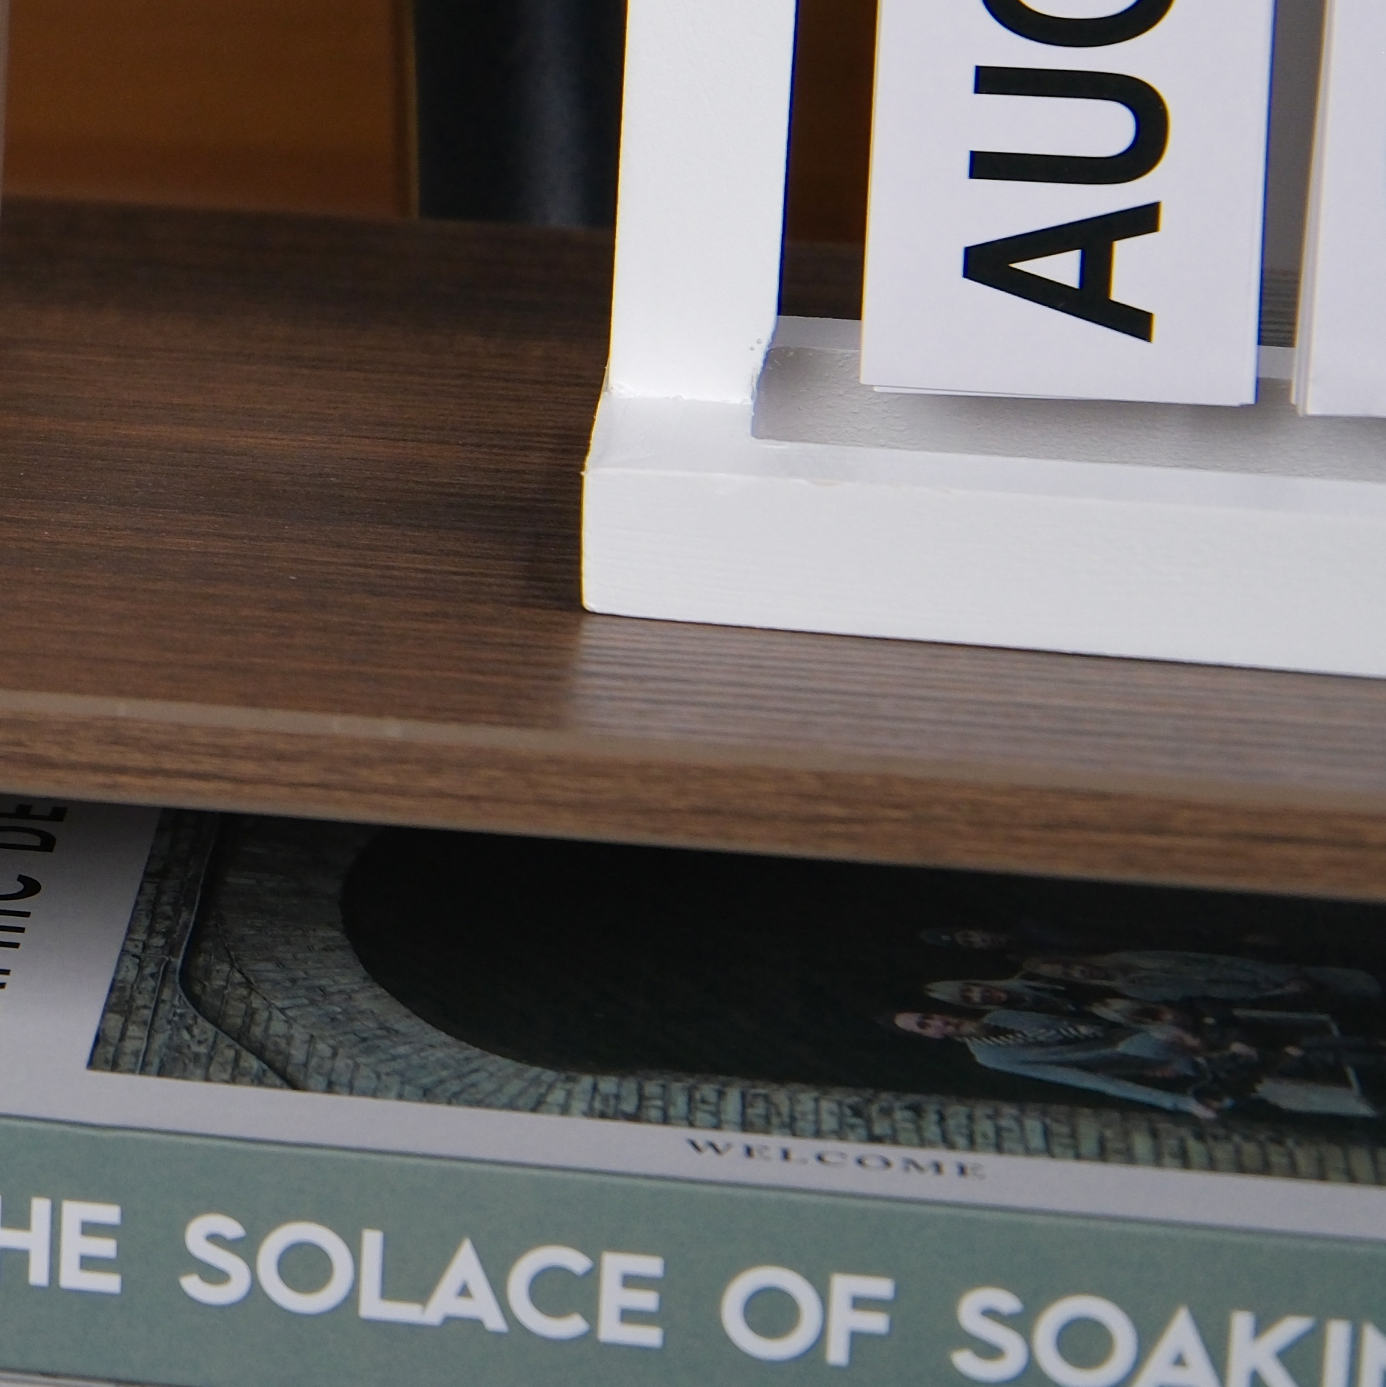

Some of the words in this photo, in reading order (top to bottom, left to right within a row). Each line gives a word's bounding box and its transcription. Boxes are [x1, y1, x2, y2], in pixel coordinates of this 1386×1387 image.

[687, 1137, 987, 1181] WELCOME
[178, 1213, 665, 1350] SOLACE
[719, 1264, 896, 1368] OF
[950, 1285, 1386, 1387] SOAKI
